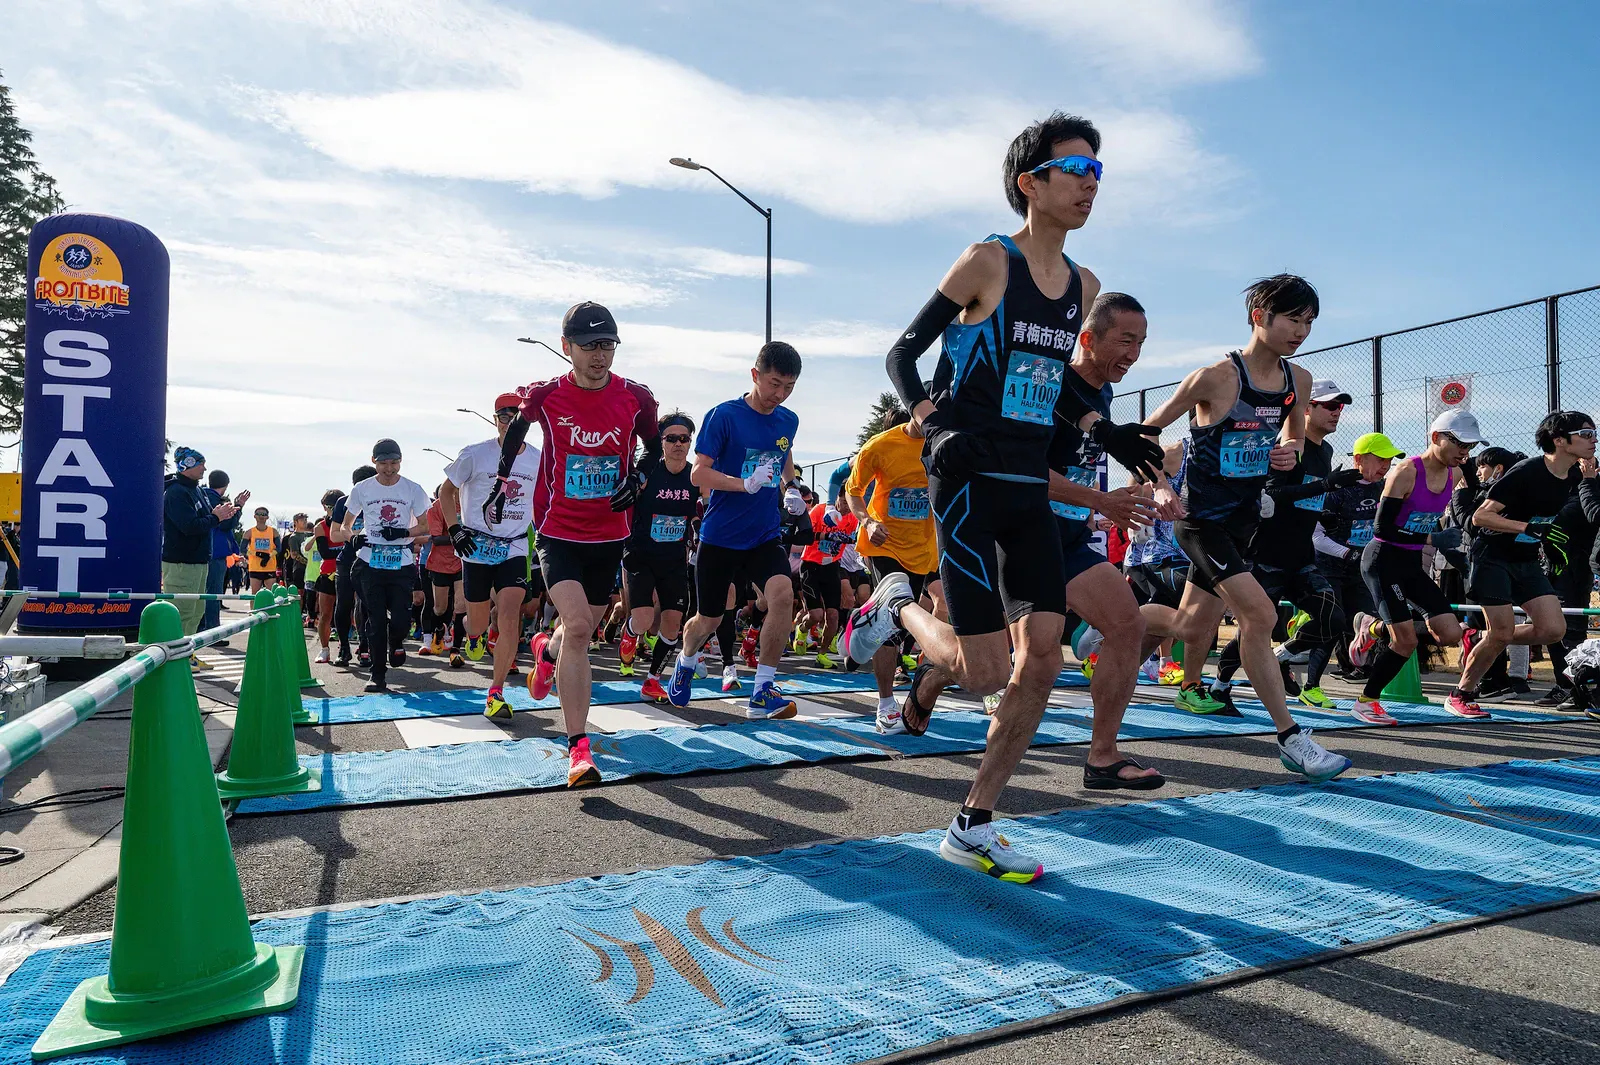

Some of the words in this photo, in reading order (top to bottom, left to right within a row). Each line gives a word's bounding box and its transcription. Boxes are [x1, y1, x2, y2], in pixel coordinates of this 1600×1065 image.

[35, 281, 129, 306] FROSTBITE
[1012, 321, 1076, 351] 青梅市役所
[1006, 382, 1016, 398] A
[1021, 381, 1059, 406] 11001
[36, 330, 114, 593] START
[1222, 452, 1231, 463] A
[1234, 449, 1270, 464] 10003
[567, 475, 575, 486] A
[577, 472, 617, 486] 11004
[890, 501, 896, 509] A
[898, 500, 929, 510] 10007
[660, 526, 685, 535] 14009
[479, 544, 508, 558] 12089
[46, 601, 64, 614] AIR
[97, 602, 131, 614] JAPAN
